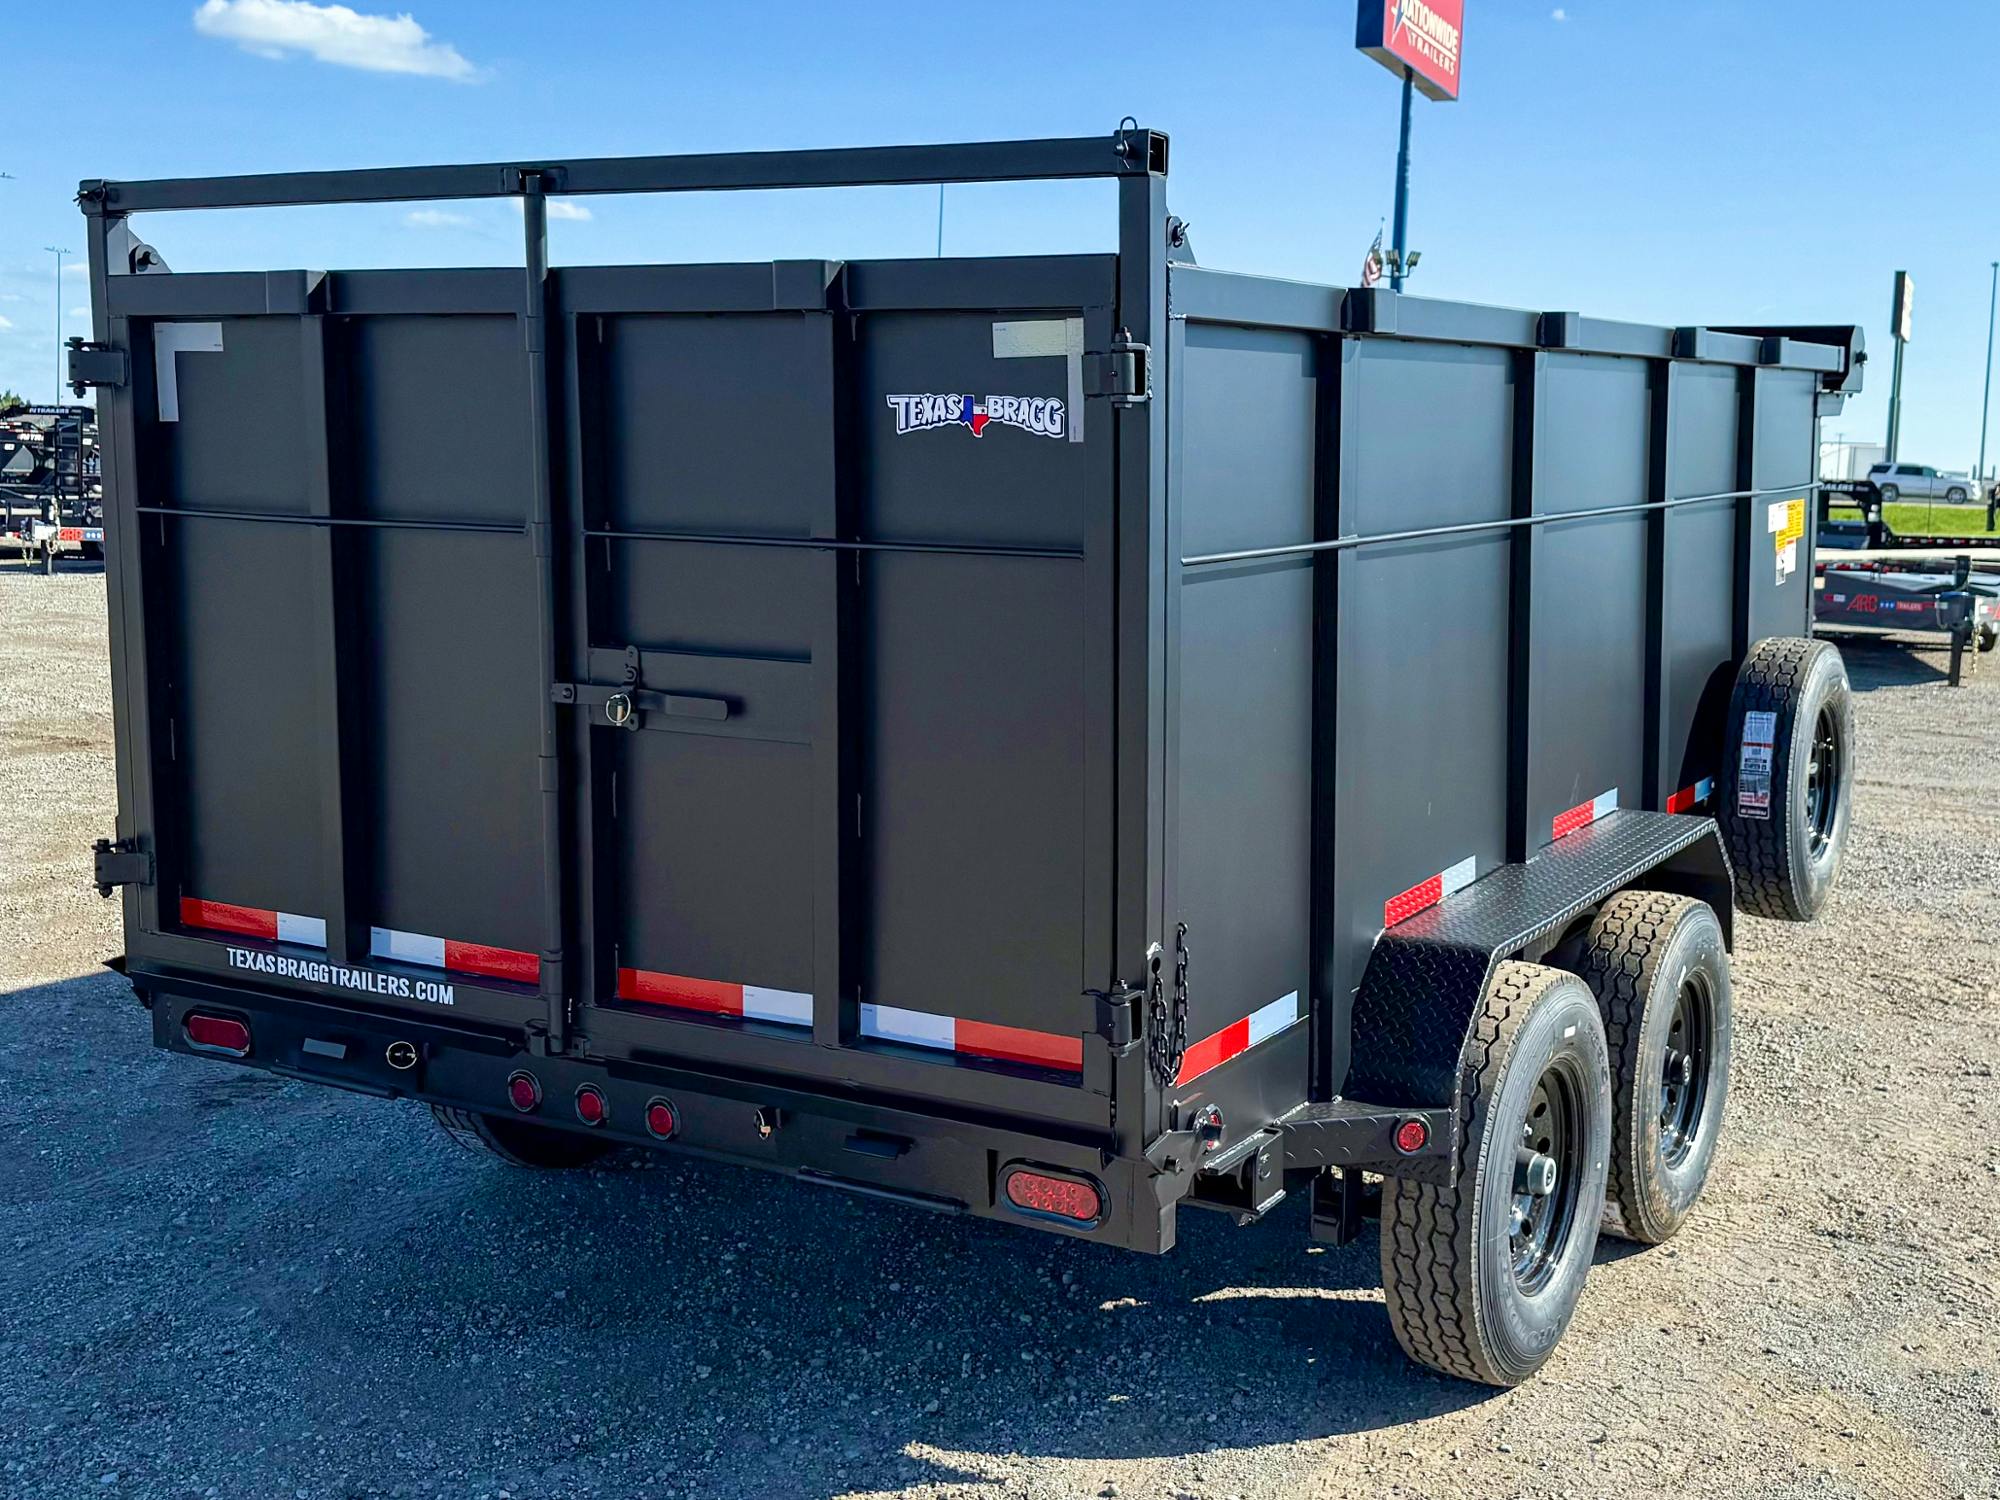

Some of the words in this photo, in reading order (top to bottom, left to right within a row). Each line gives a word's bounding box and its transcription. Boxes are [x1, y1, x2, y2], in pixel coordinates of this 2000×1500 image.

[1411, 32, 1454, 75] TRAILERS
[888, 395, 963, 432] TEXAS
[987, 396, 1065, 437] BRAGG
[226, 947, 454, 1006] TEXASBRAGGTRAILERS.COM
